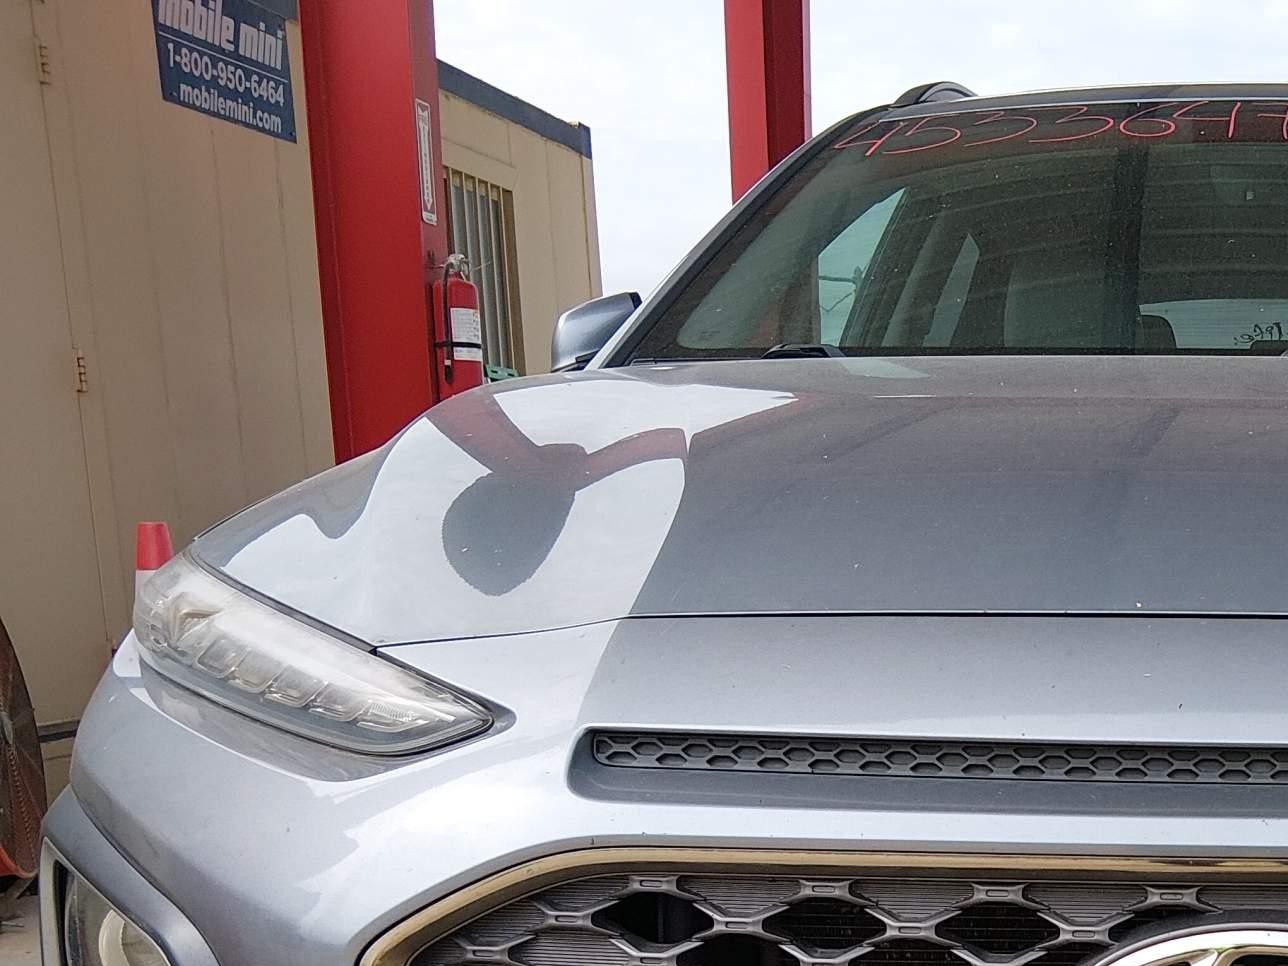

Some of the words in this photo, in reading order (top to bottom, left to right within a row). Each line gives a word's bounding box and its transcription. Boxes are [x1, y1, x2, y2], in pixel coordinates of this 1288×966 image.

[158, 0, 234, 51] mobile
[239, 22, 283, 70] mini
[167, 43, 285, 107] 1-800-950-6464
[179, 83, 282, 133] mobilemini.com
